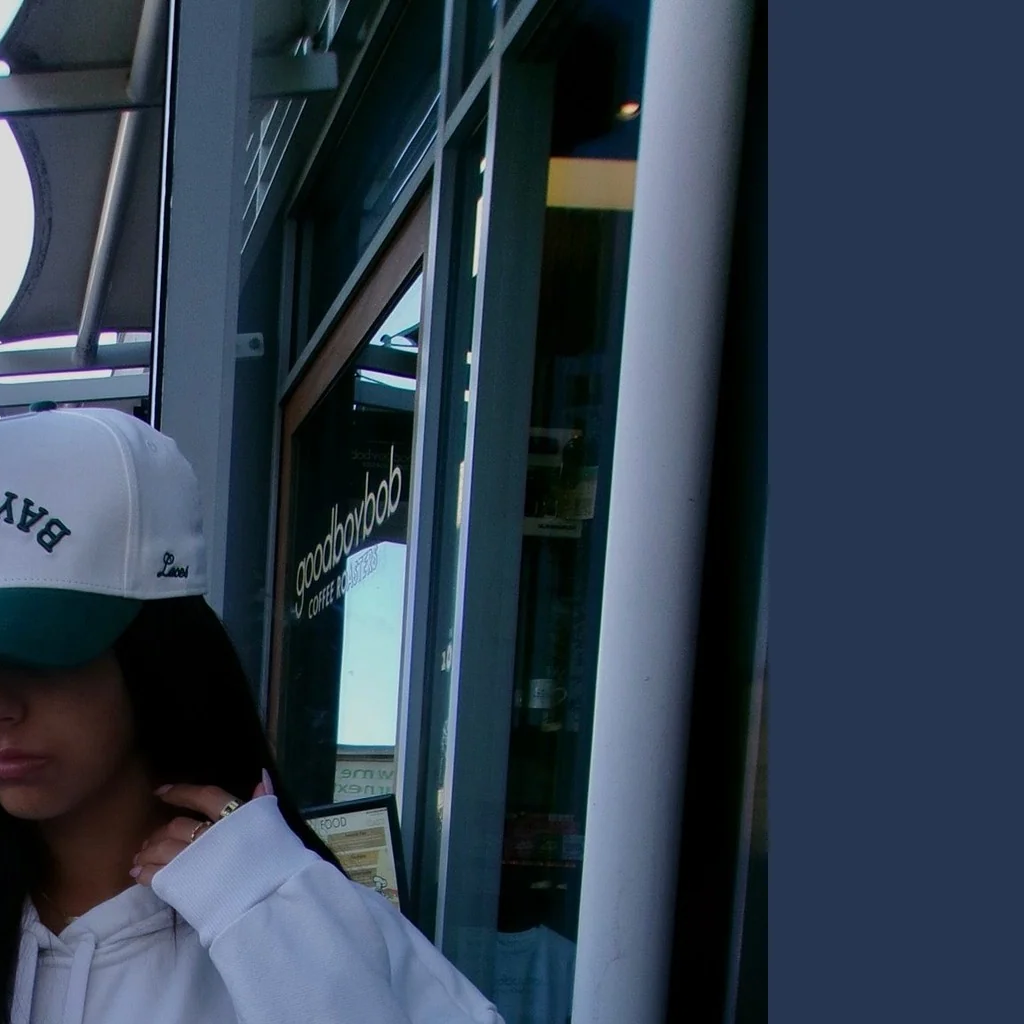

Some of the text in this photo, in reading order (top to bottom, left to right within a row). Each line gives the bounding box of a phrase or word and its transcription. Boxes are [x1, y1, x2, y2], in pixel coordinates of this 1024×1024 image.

[295, 443, 402, 619] goodboybob
[307, 544, 379, 620] COFFEE ROASTERS
[320, 816, 347, 830] FOOD
